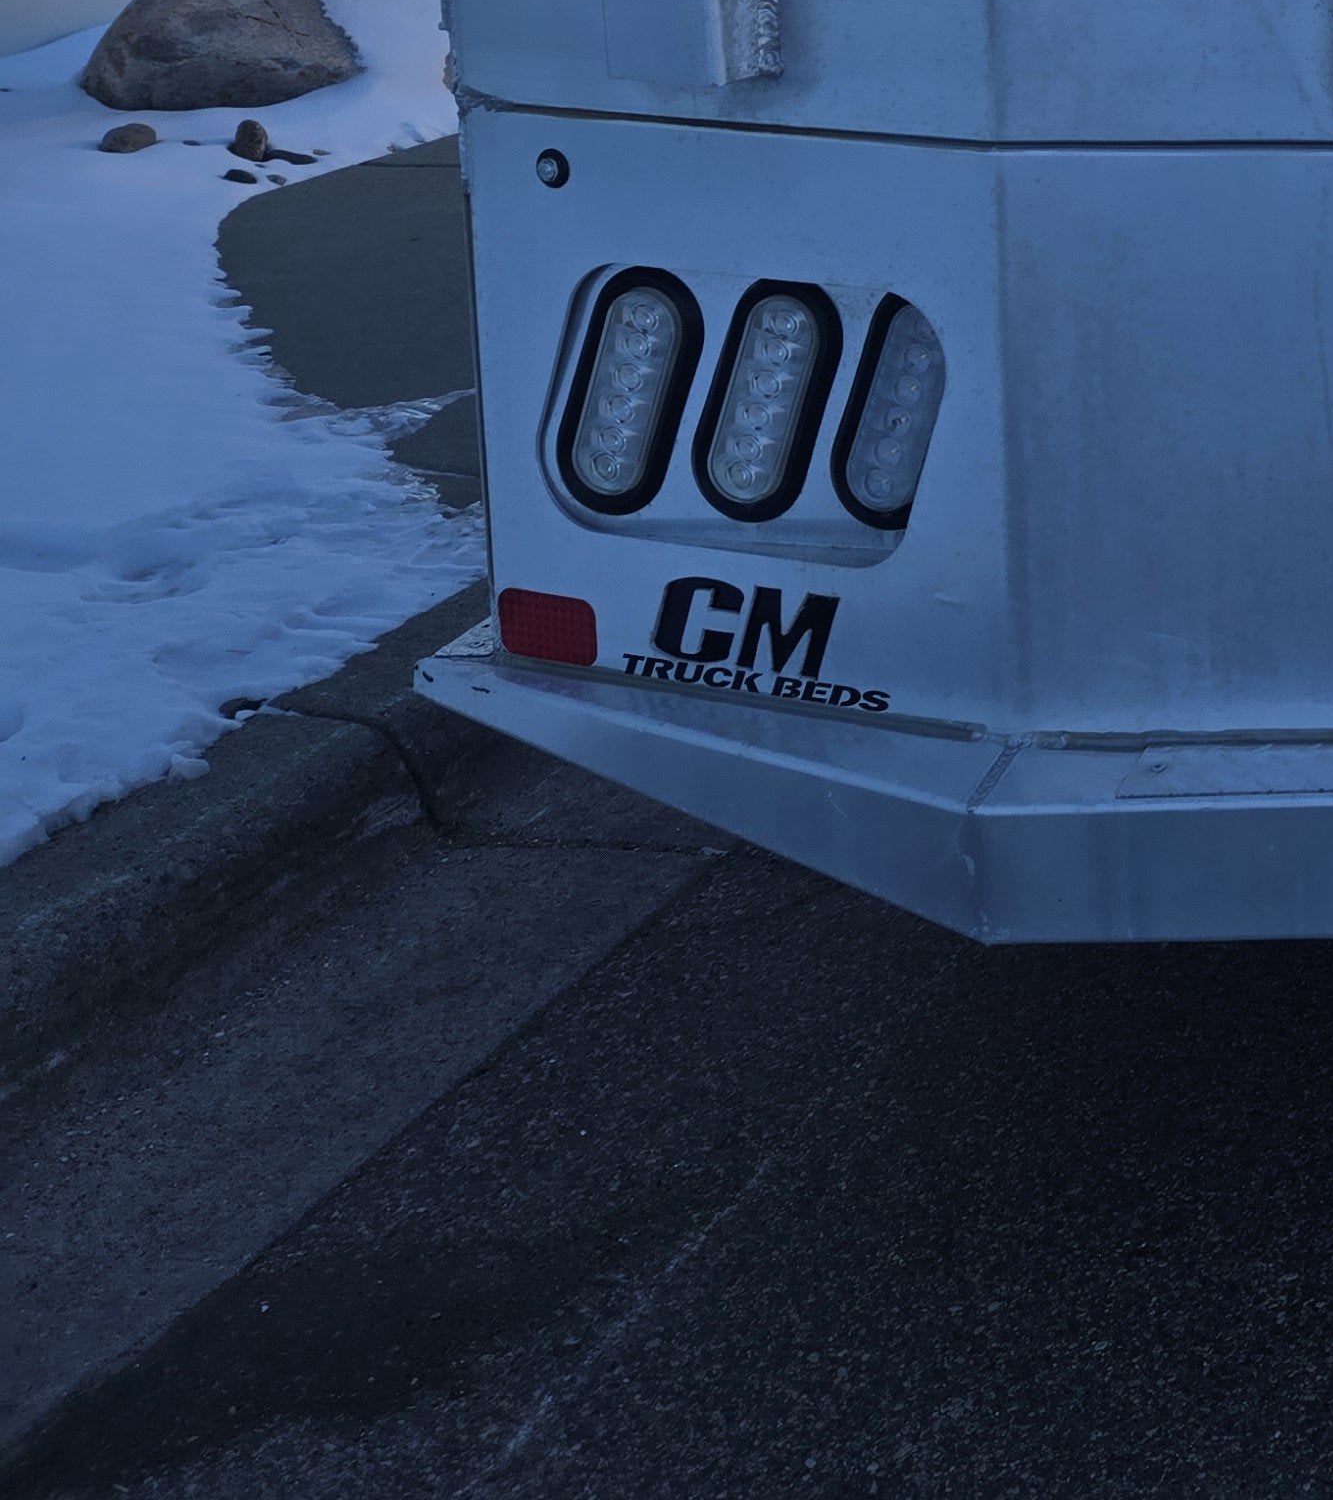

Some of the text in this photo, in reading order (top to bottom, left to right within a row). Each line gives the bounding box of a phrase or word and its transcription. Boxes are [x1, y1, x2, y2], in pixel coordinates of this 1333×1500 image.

[653, 576, 842, 679] CM
[622, 653, 891, 712] TRUCK BEDS
